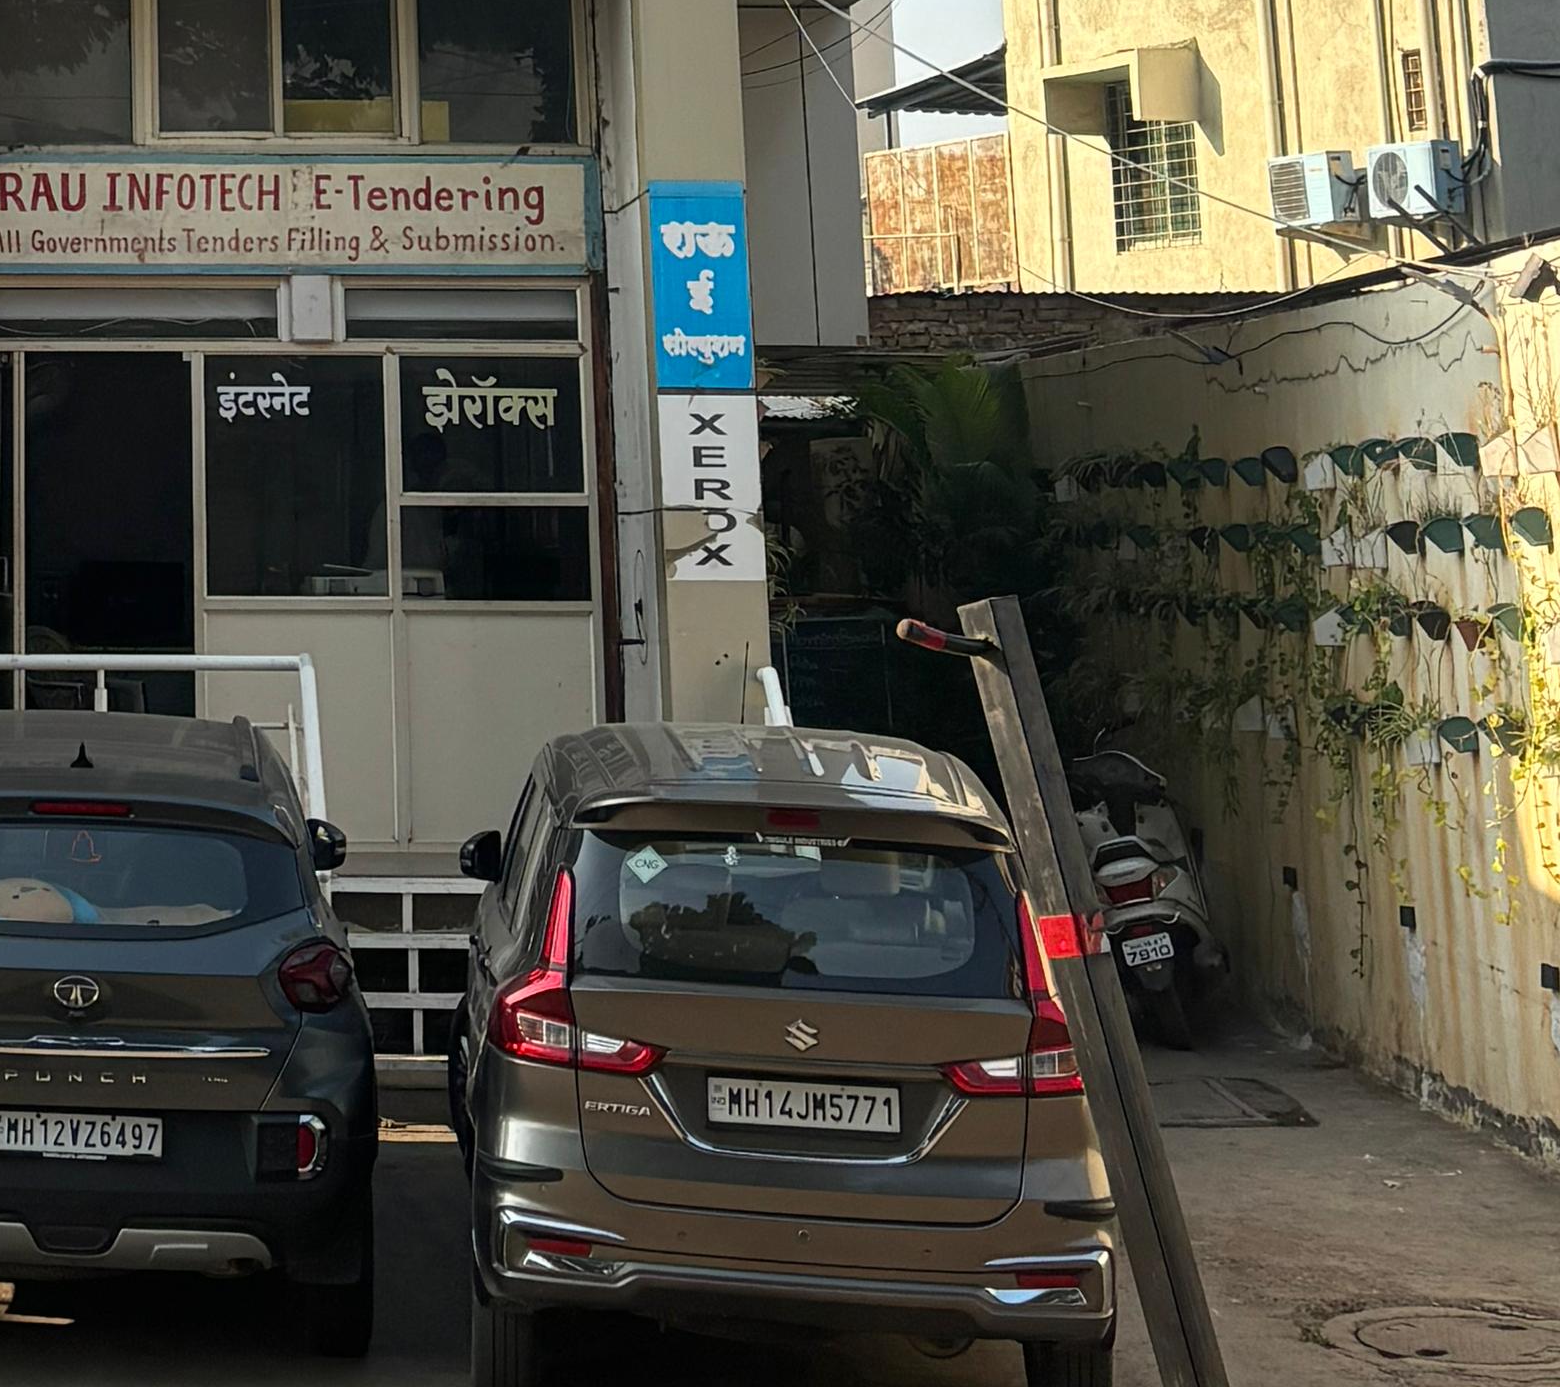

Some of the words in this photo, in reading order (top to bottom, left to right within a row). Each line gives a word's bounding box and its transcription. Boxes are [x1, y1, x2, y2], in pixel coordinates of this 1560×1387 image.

[102, 172, 280, 212] INFOTECH
[314, 174, 545, 225] E-Tendering
[181, 227, 279, 254] Tenders
[287, 226, 360, 262] Filling
[369, 226, 390, 254] &
[217, 371, 311, 423] इंटरनेट
[422, 368, 558, 434] झेरॉक्स
[1127, 944, 1171, 964] 7910
[584, 1100, 653, 1117] ERTIGA
[728, 1087, 894, 1127] MH14JM5771
[6, 1117, 160, 1152] MH12VZ6497
